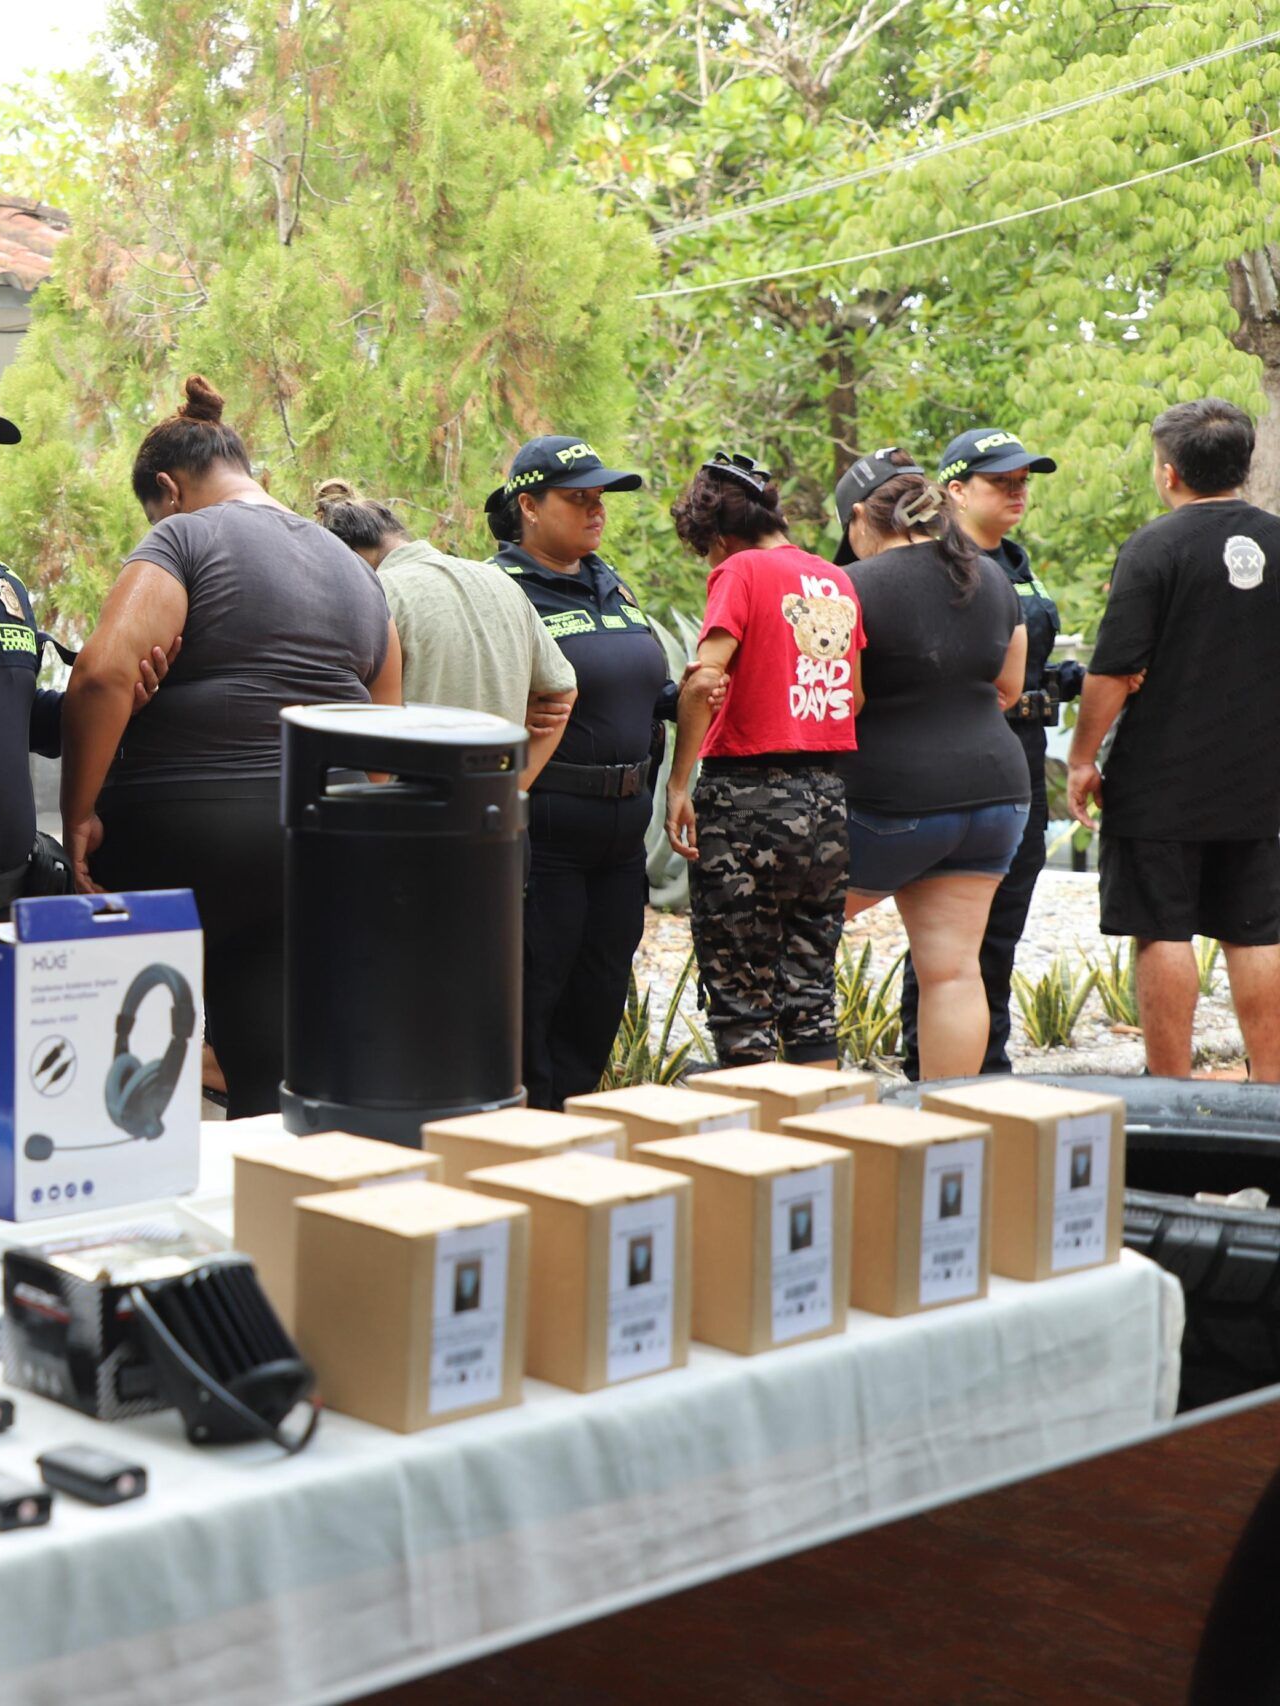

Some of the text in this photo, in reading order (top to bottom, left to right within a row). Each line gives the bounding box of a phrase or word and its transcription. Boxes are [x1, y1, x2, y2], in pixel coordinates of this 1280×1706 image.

[800, 574, 840, 600] NO
[796, 654, 851, 689] BAD
[789, 685, 853, 722] DAYS
